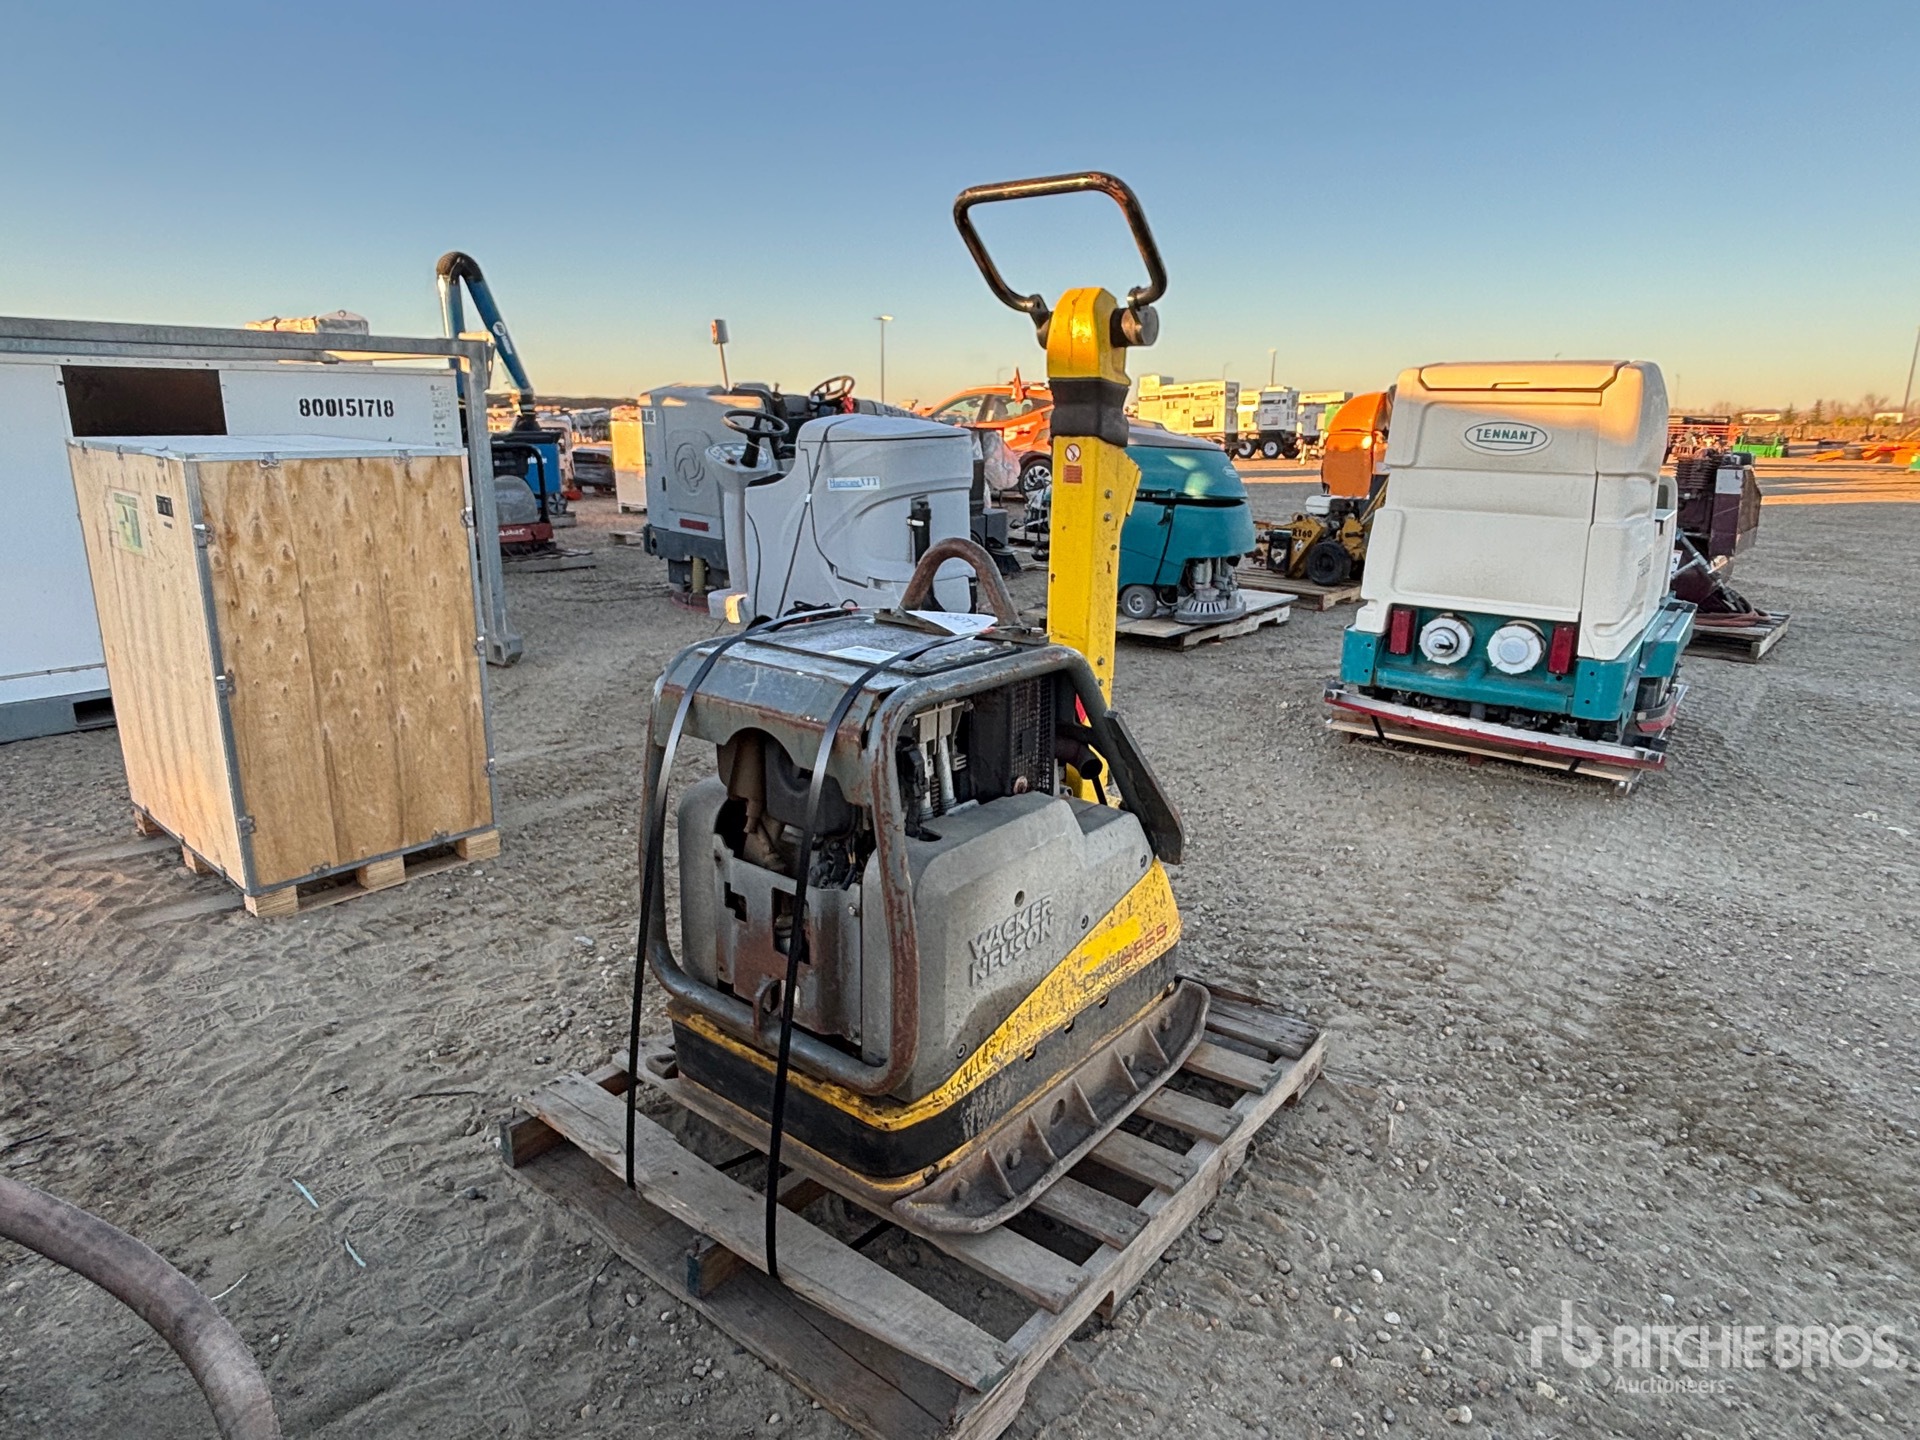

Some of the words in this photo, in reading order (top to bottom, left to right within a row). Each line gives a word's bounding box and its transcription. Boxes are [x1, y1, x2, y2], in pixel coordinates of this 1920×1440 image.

[299, 398, 395, 417] 800151718
[1476, 429, 1537, 444] TENNANT
[968, 895, 1053, 960] WACKER
[969, 917, 1052, 987] NEUSON
